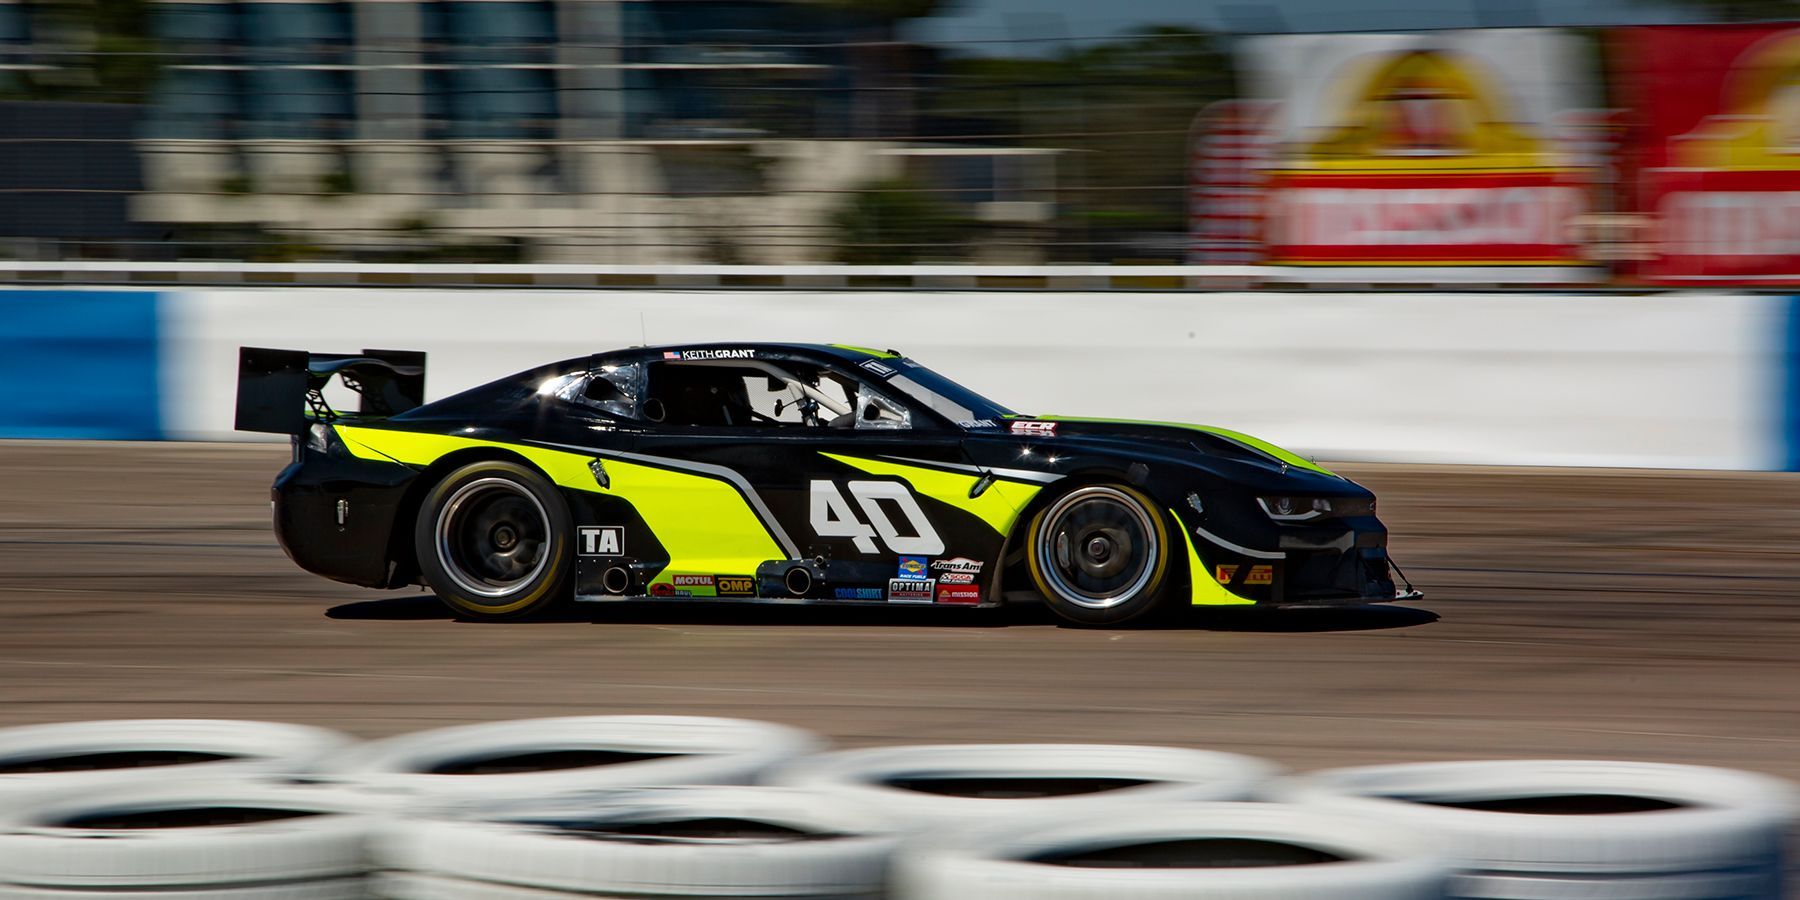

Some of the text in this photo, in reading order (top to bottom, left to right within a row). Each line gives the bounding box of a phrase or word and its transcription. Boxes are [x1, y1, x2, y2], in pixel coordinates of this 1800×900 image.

[1011, 420, 1056, 430] ECR
[809, 479, 945, 556] 40
[581, 529, 619, 553] TA
[935, 560, 980, 571] Trans Am
[675, 576, 714, 586] MOTUL
[718, 580, 753, 592] OMP
[892, 582, 931, 592] OPTIMA
[834, 588, 883, 600] COOLSHIRT
